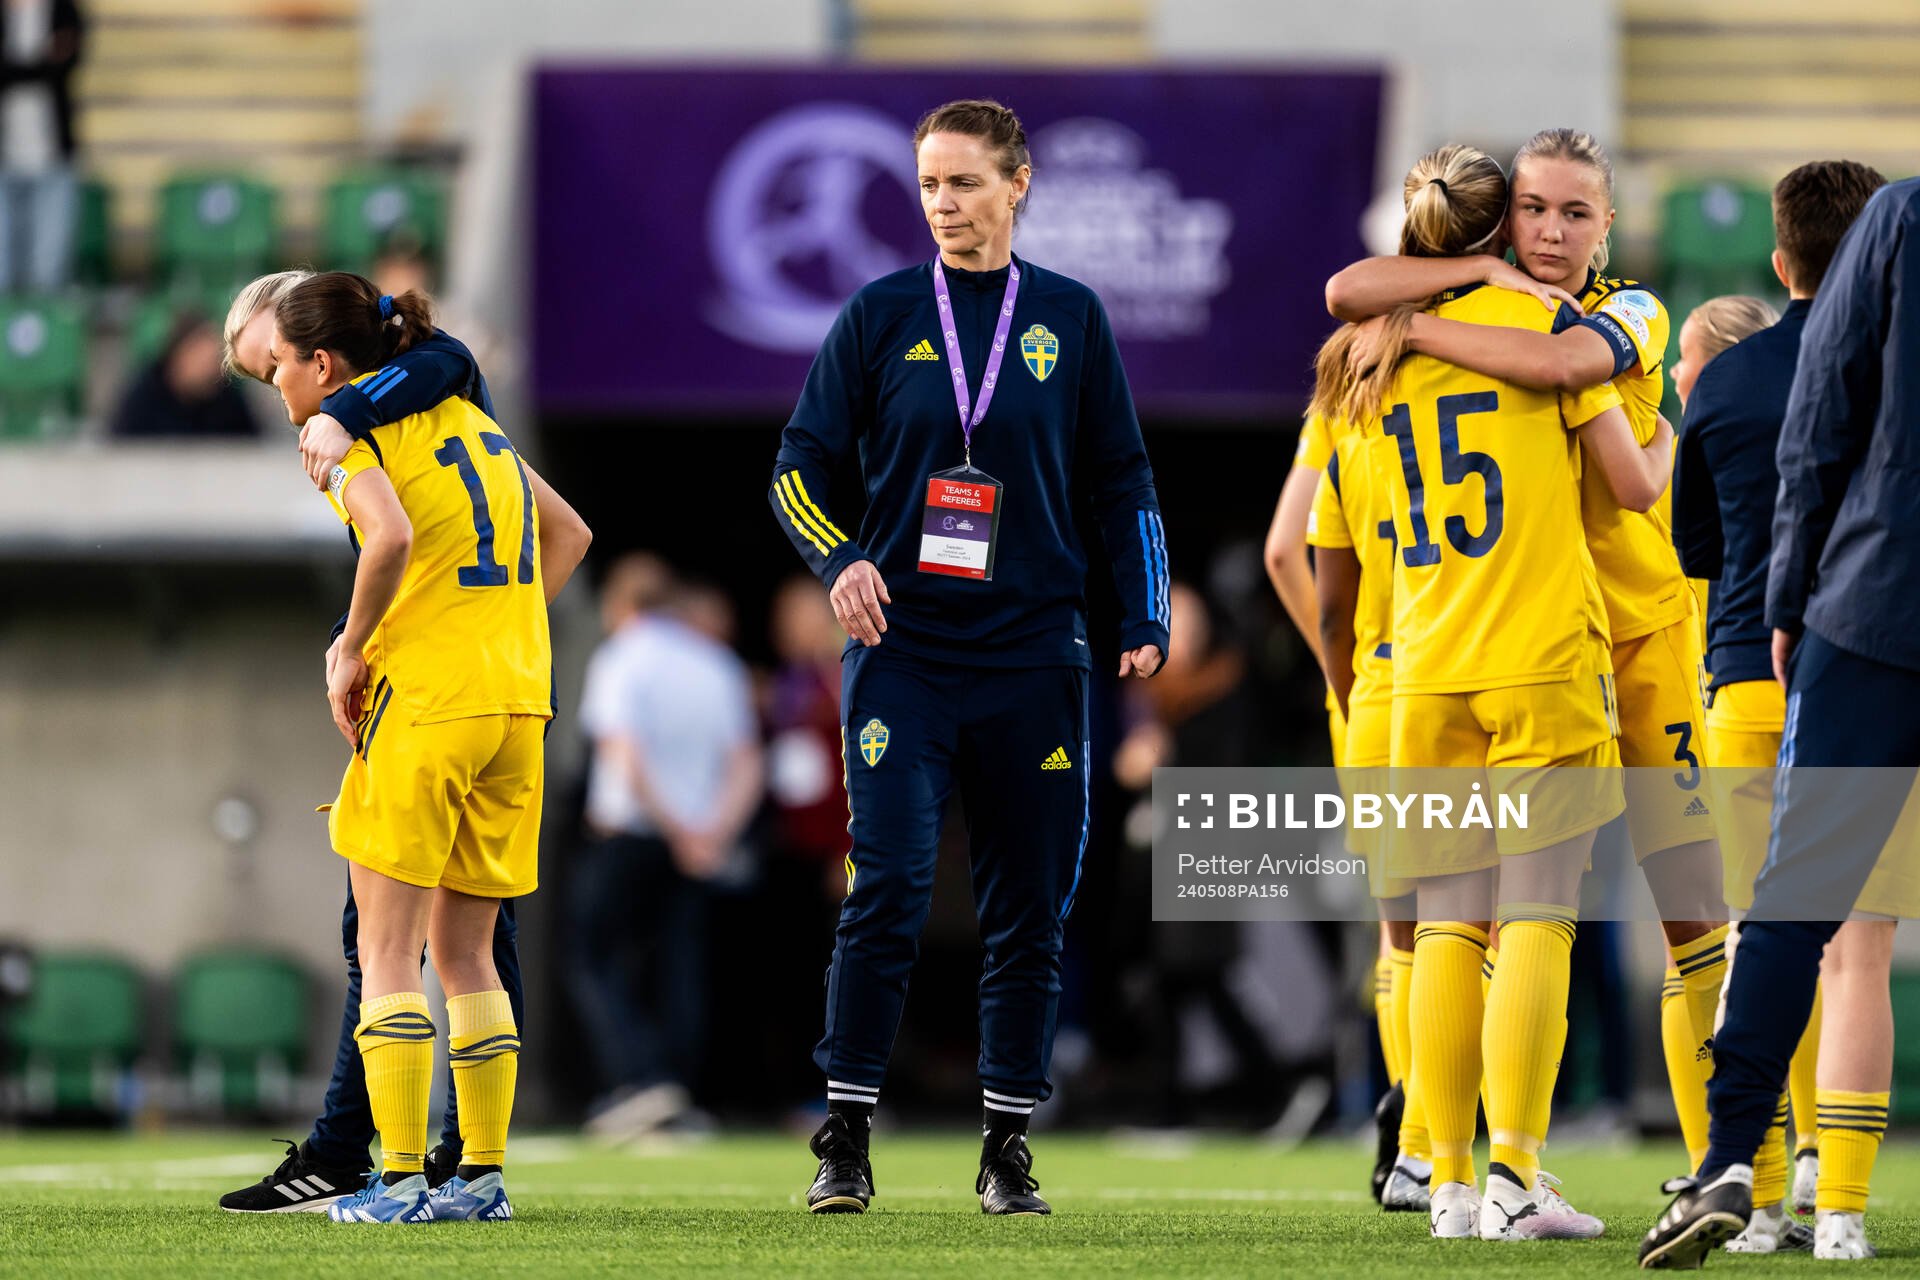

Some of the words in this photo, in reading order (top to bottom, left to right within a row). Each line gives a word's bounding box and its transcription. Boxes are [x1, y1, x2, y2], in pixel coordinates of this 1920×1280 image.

[1597, 316, 1632, 352] RESPECT
[904, 352, 940, 361] adidas
[1382, 390, 1504, 567] 15
[944, 485, 972, 497] TEAMS
[973, 489, 980, 497] &
[941, 494, 982, 507] REFEREES
[434, 432, 534, 586] 17
[1664, 721, 1701, 791] 3
[1041, 760, 1072, 770] adidas
[1683, 808, 1710, 817] adidas
